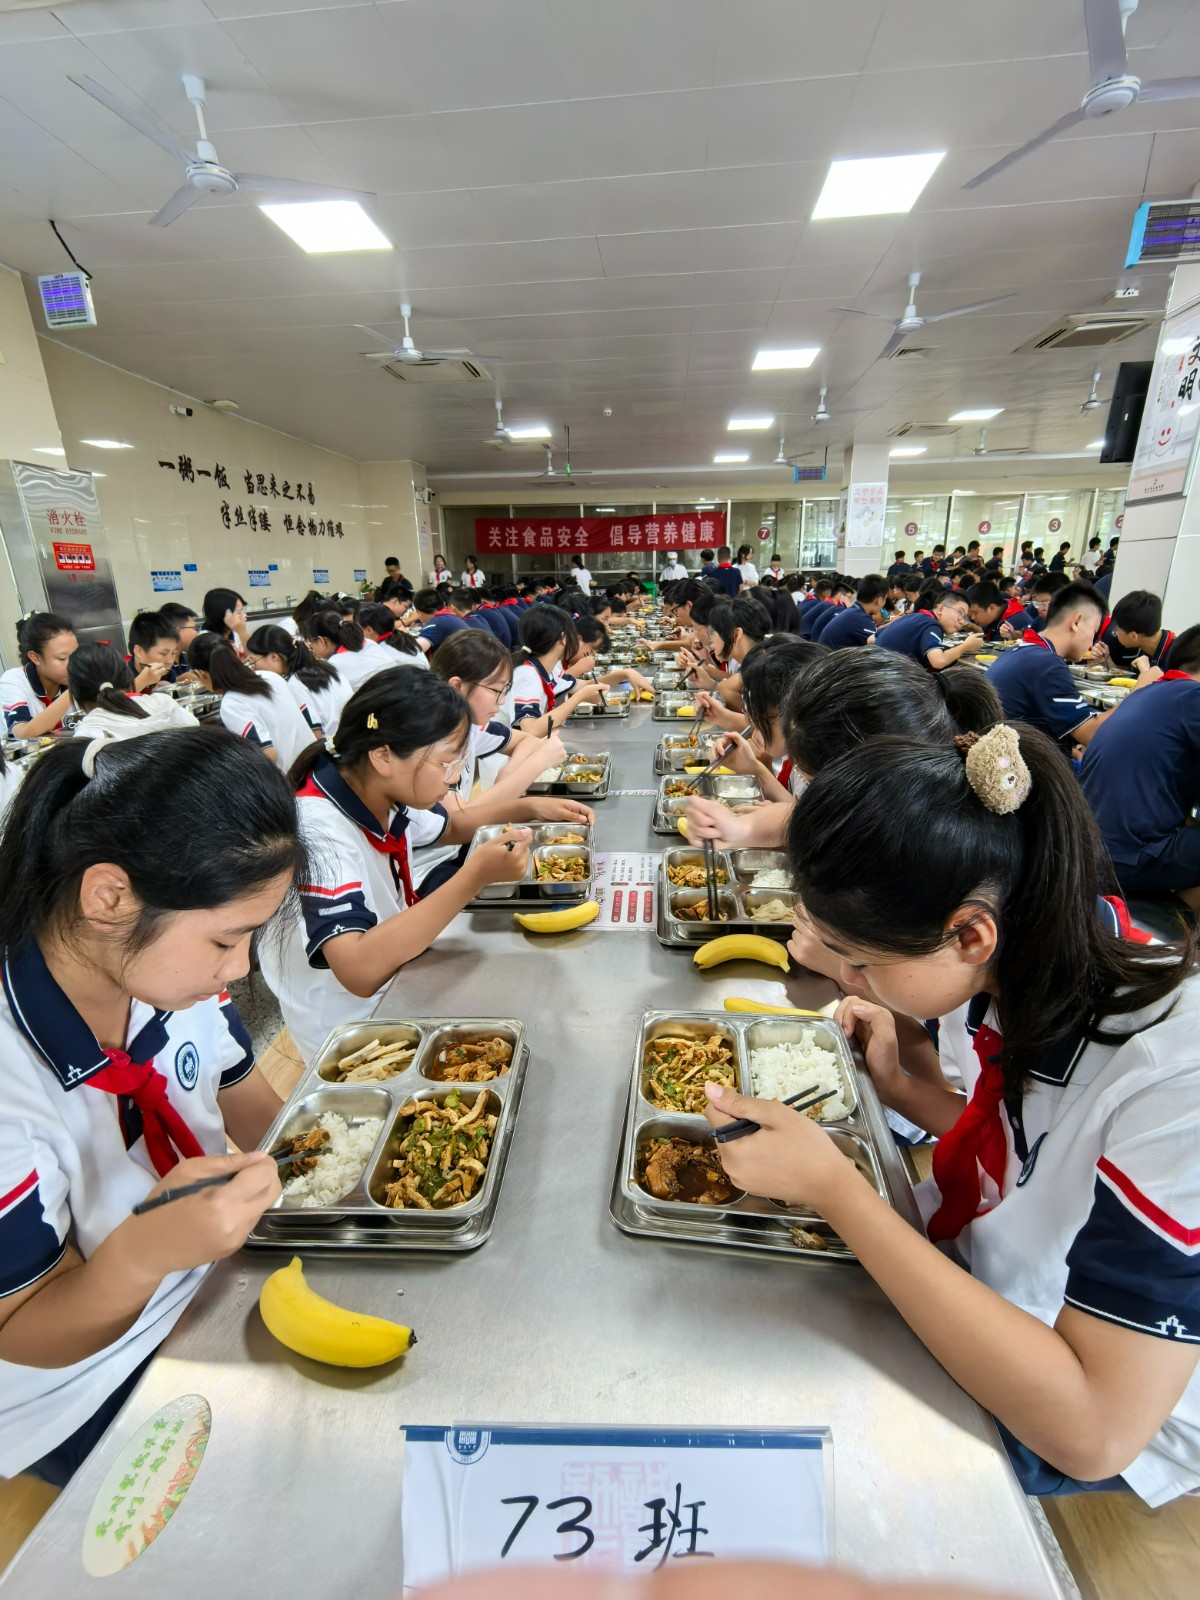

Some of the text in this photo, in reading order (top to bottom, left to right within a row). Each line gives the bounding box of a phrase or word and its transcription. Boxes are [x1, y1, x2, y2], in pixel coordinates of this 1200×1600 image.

[158, 454, 315, 505] 一粥一饭 当思来之不易
[47, 509, 86, 527] 消火栓
[220, 500, 272, 533] 半丝半缕
[488, 520, 715, 548] 关注食品安全 倡导营养健康
[500, 1495, 595, 1560] 73
[633, 1482, 715, 1572] 班
